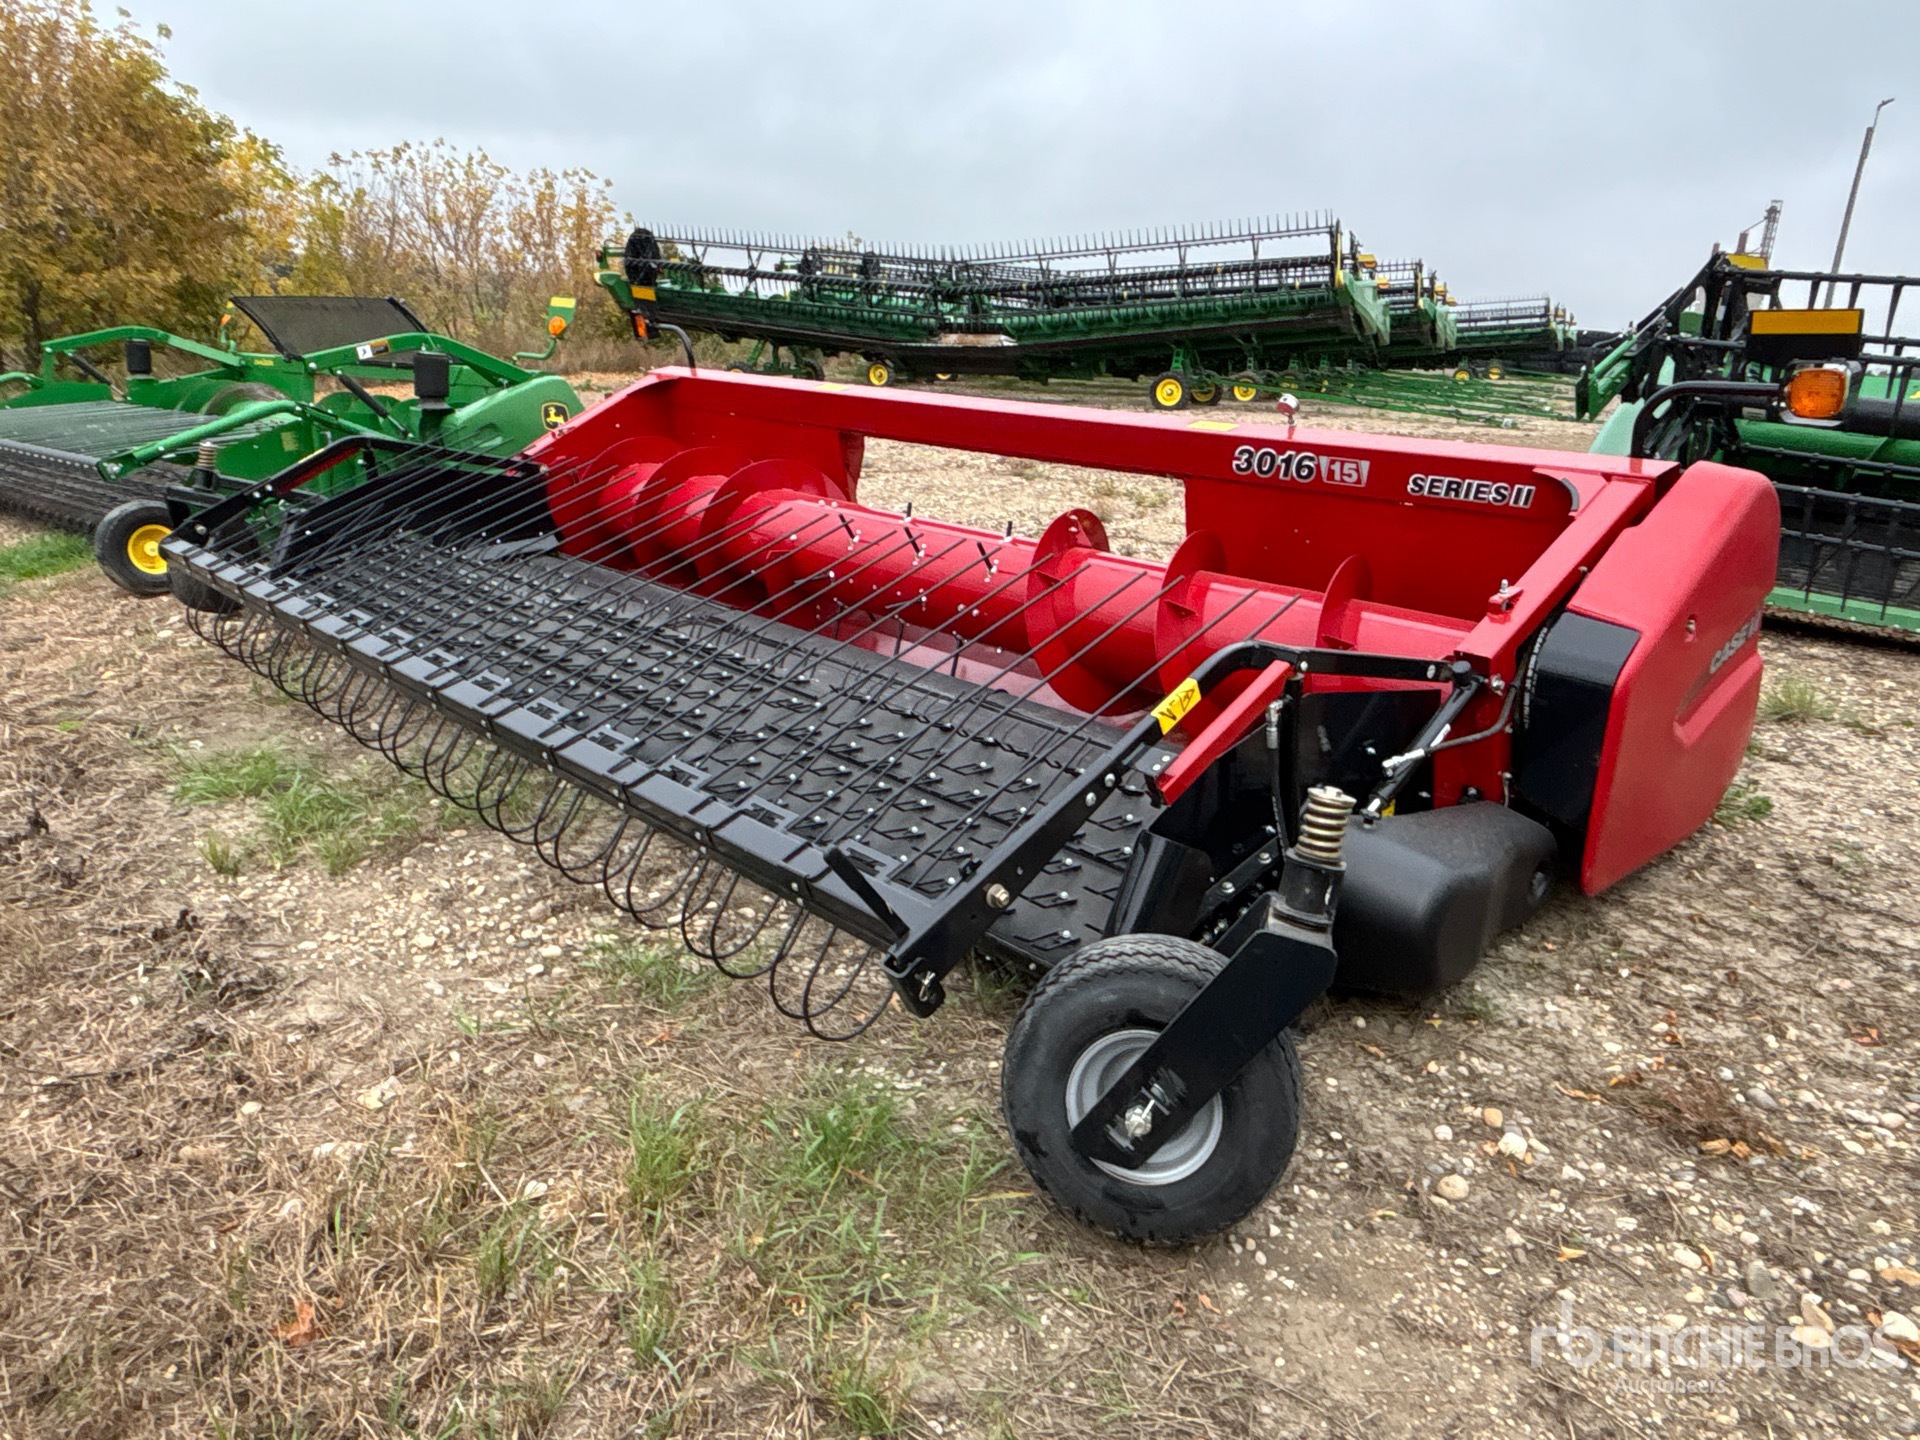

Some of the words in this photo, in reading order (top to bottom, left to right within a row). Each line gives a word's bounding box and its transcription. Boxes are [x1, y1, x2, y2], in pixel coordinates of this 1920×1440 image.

[1232, 445, 1317, 482] 3016
[1330, 461, 1358, 483] 15
[1407, 473, 1511, 505] SERIES
